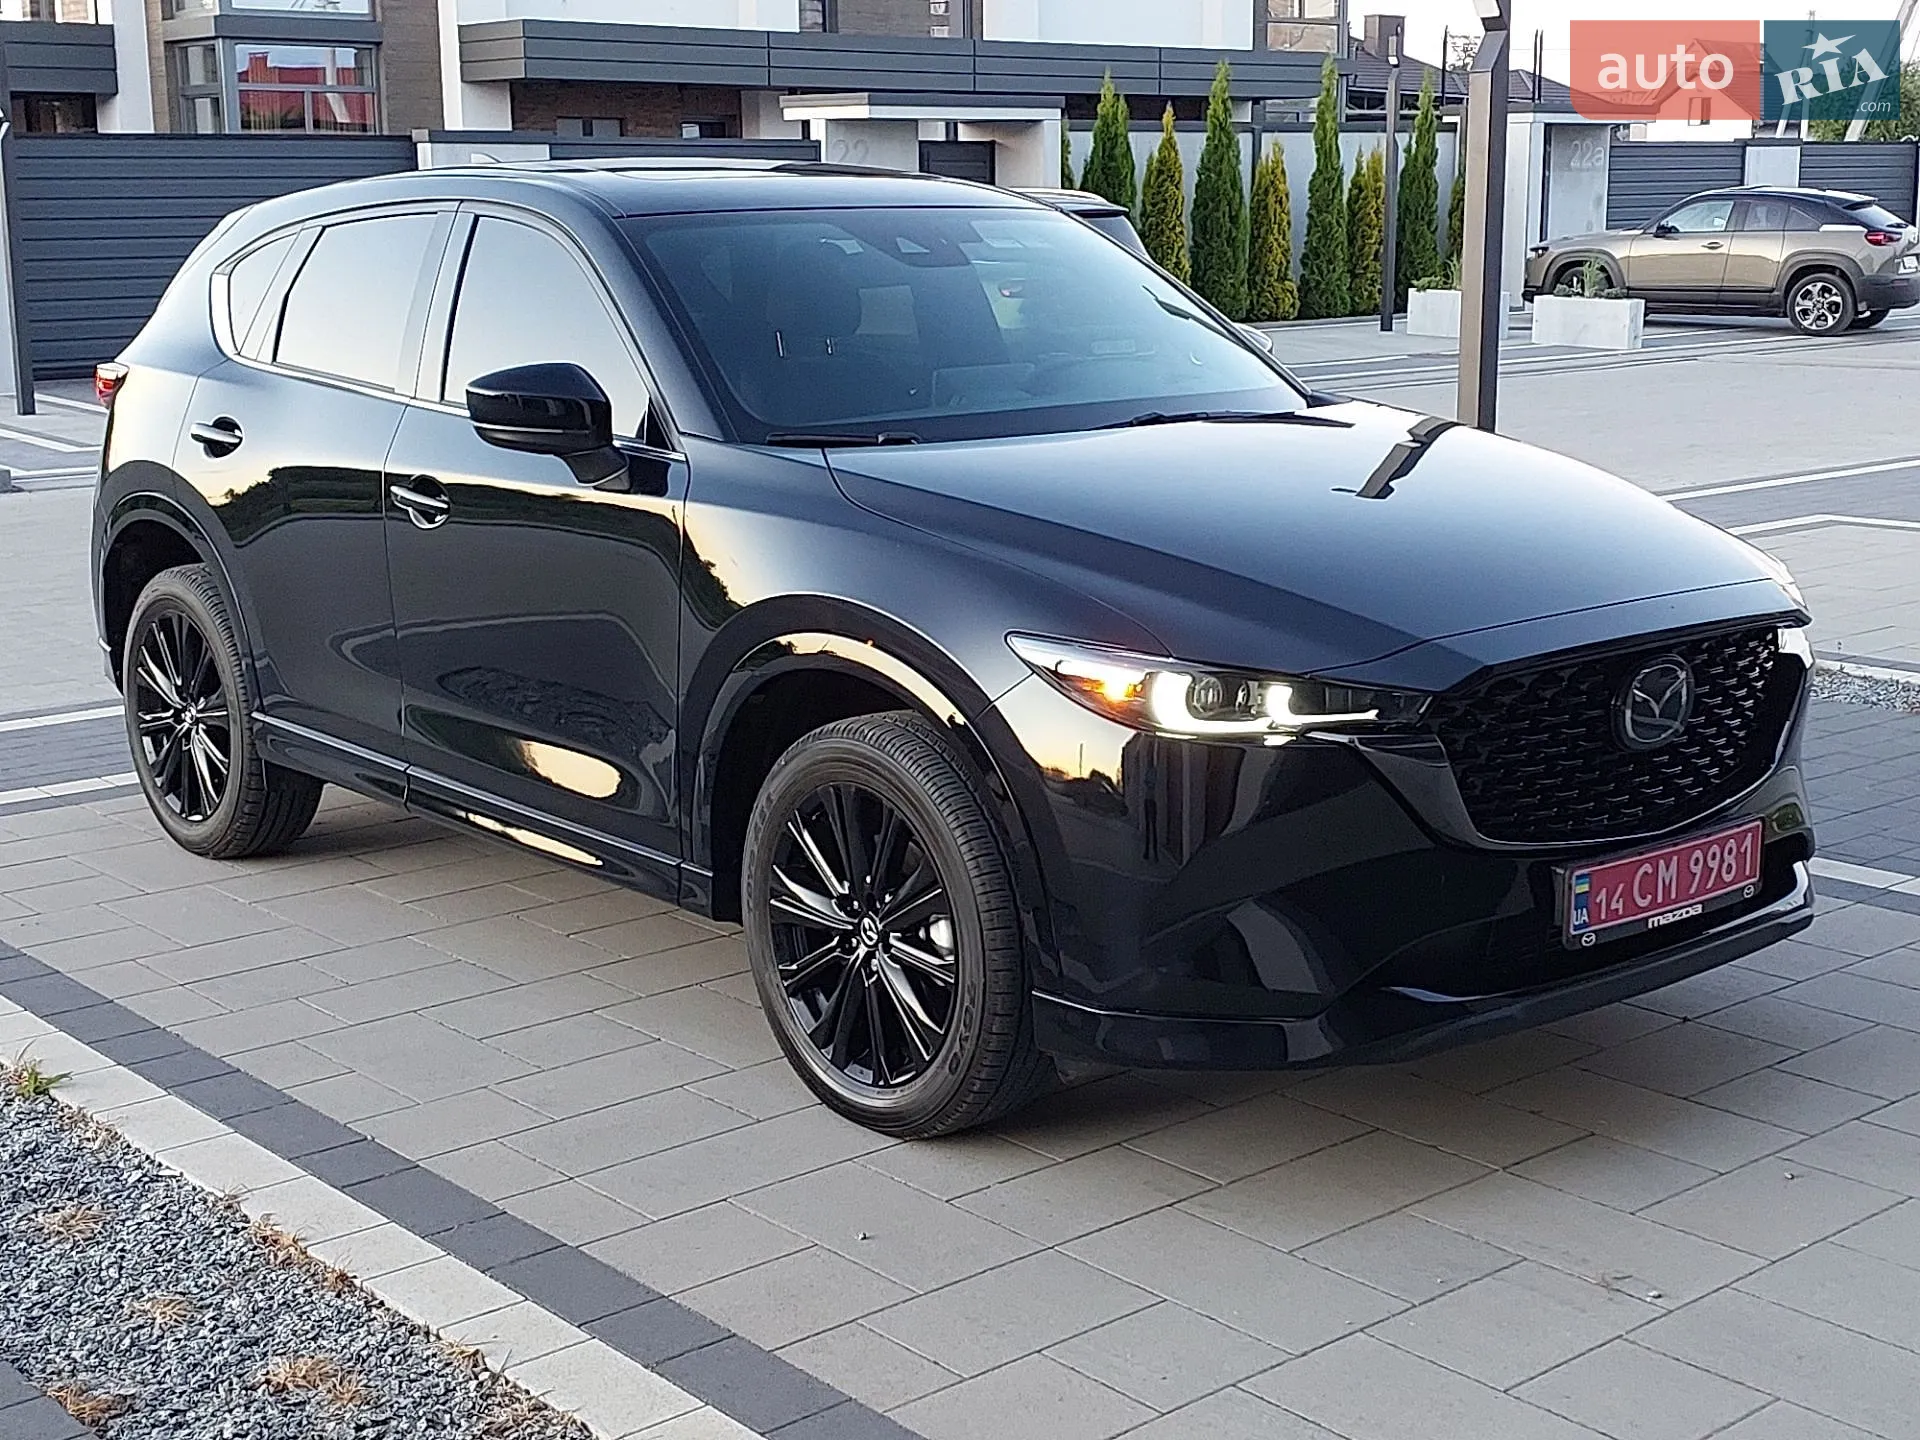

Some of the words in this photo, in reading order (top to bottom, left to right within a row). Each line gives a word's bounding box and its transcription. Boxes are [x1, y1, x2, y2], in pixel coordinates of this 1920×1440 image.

[1570, 140, 1605, 166] 22a
[1596, 882, 1625, 920] 14
[1632, 855, 1679, 908] CM
[1689, 832, 1753, 894] 9981
[1573, 908, 1589, 926] UA
[1648, 903, 1704, 929] mazda
